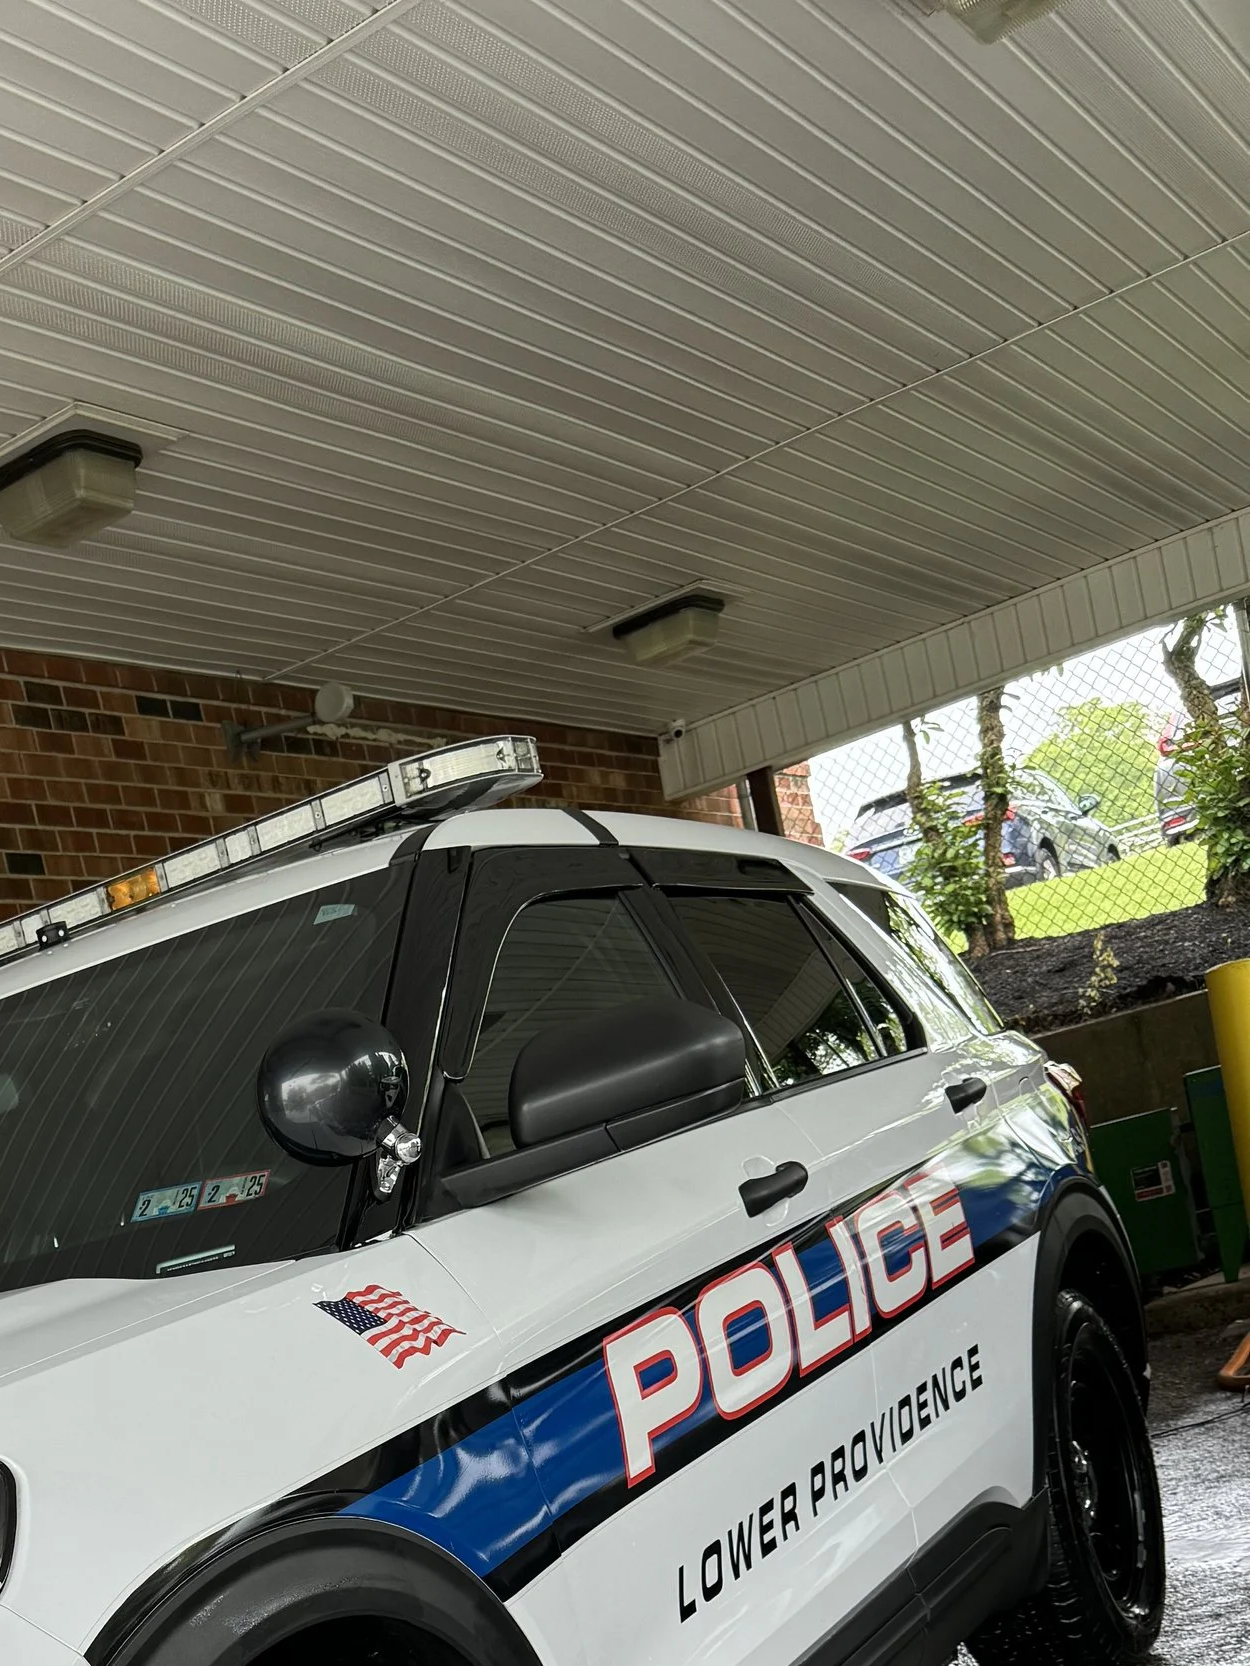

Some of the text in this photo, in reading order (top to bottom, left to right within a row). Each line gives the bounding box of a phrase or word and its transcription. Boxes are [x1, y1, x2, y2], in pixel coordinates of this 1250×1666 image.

[178, 1186, 197, 1209] 25
[246, 1174, 266, 1197] 25
[603, 1165, 975, 1488] POLICE
[677, 1343, 984, 1624] LOWER PROVIDENCE
